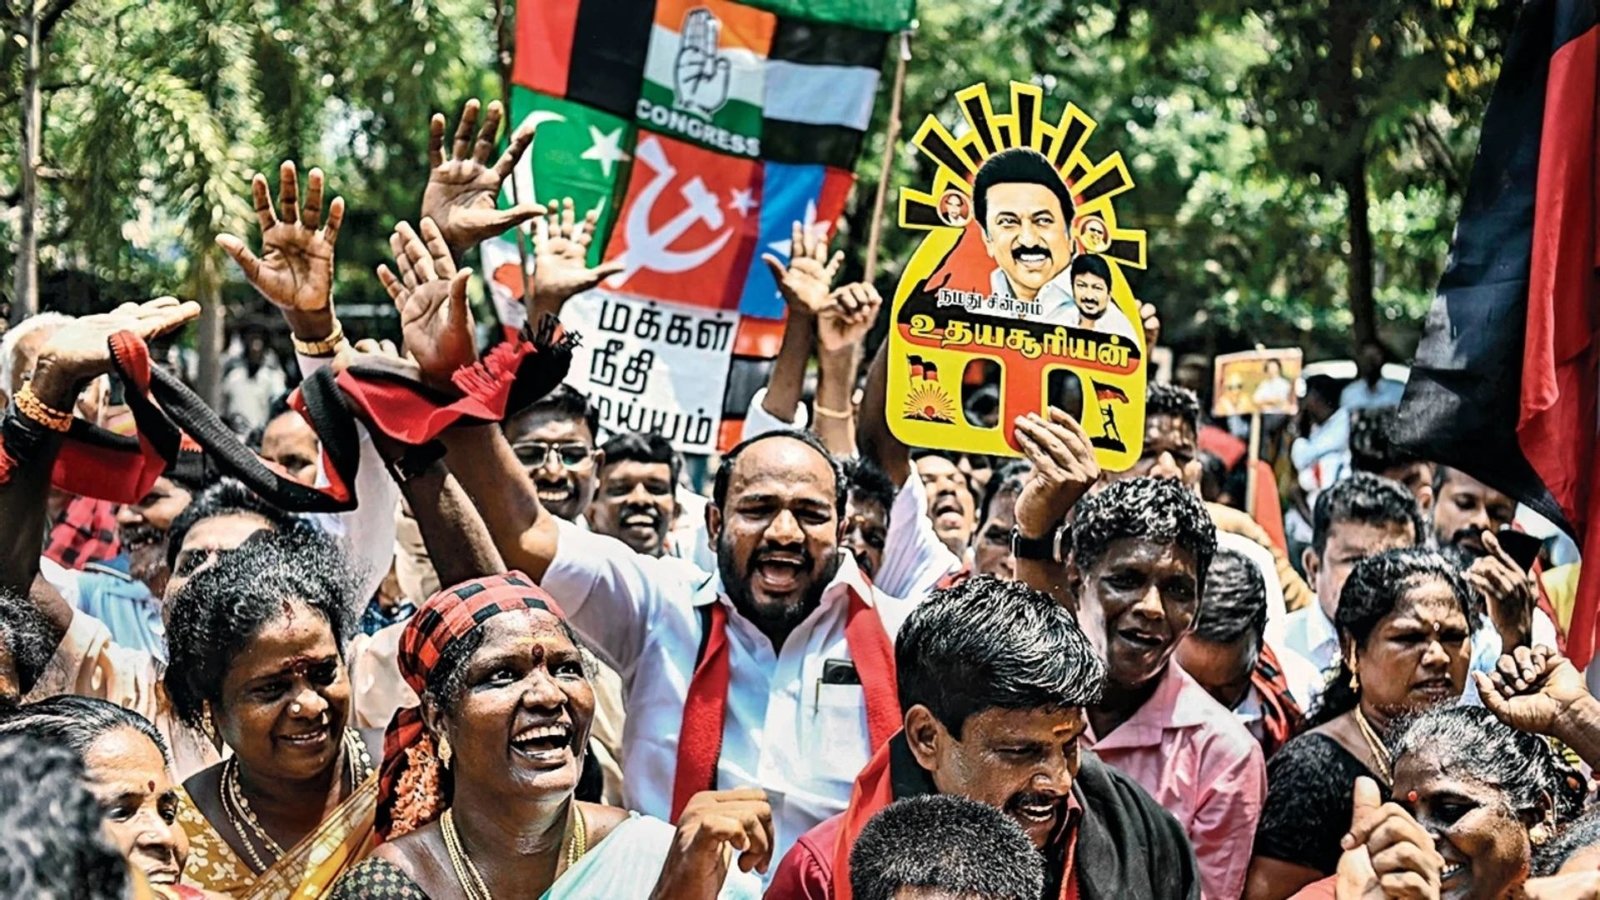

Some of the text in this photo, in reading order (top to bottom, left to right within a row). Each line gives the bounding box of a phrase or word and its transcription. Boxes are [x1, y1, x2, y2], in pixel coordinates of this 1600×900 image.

[636, 98, 760, 156] CONGRESS
[598, 299, 734, 352] மக்கள்
[938, 288, 1043, 316] நமது சின்னம்
[589, 339, 655, 395] நீதி
[910, 314, 1132, 368] உதயசூரியன்
